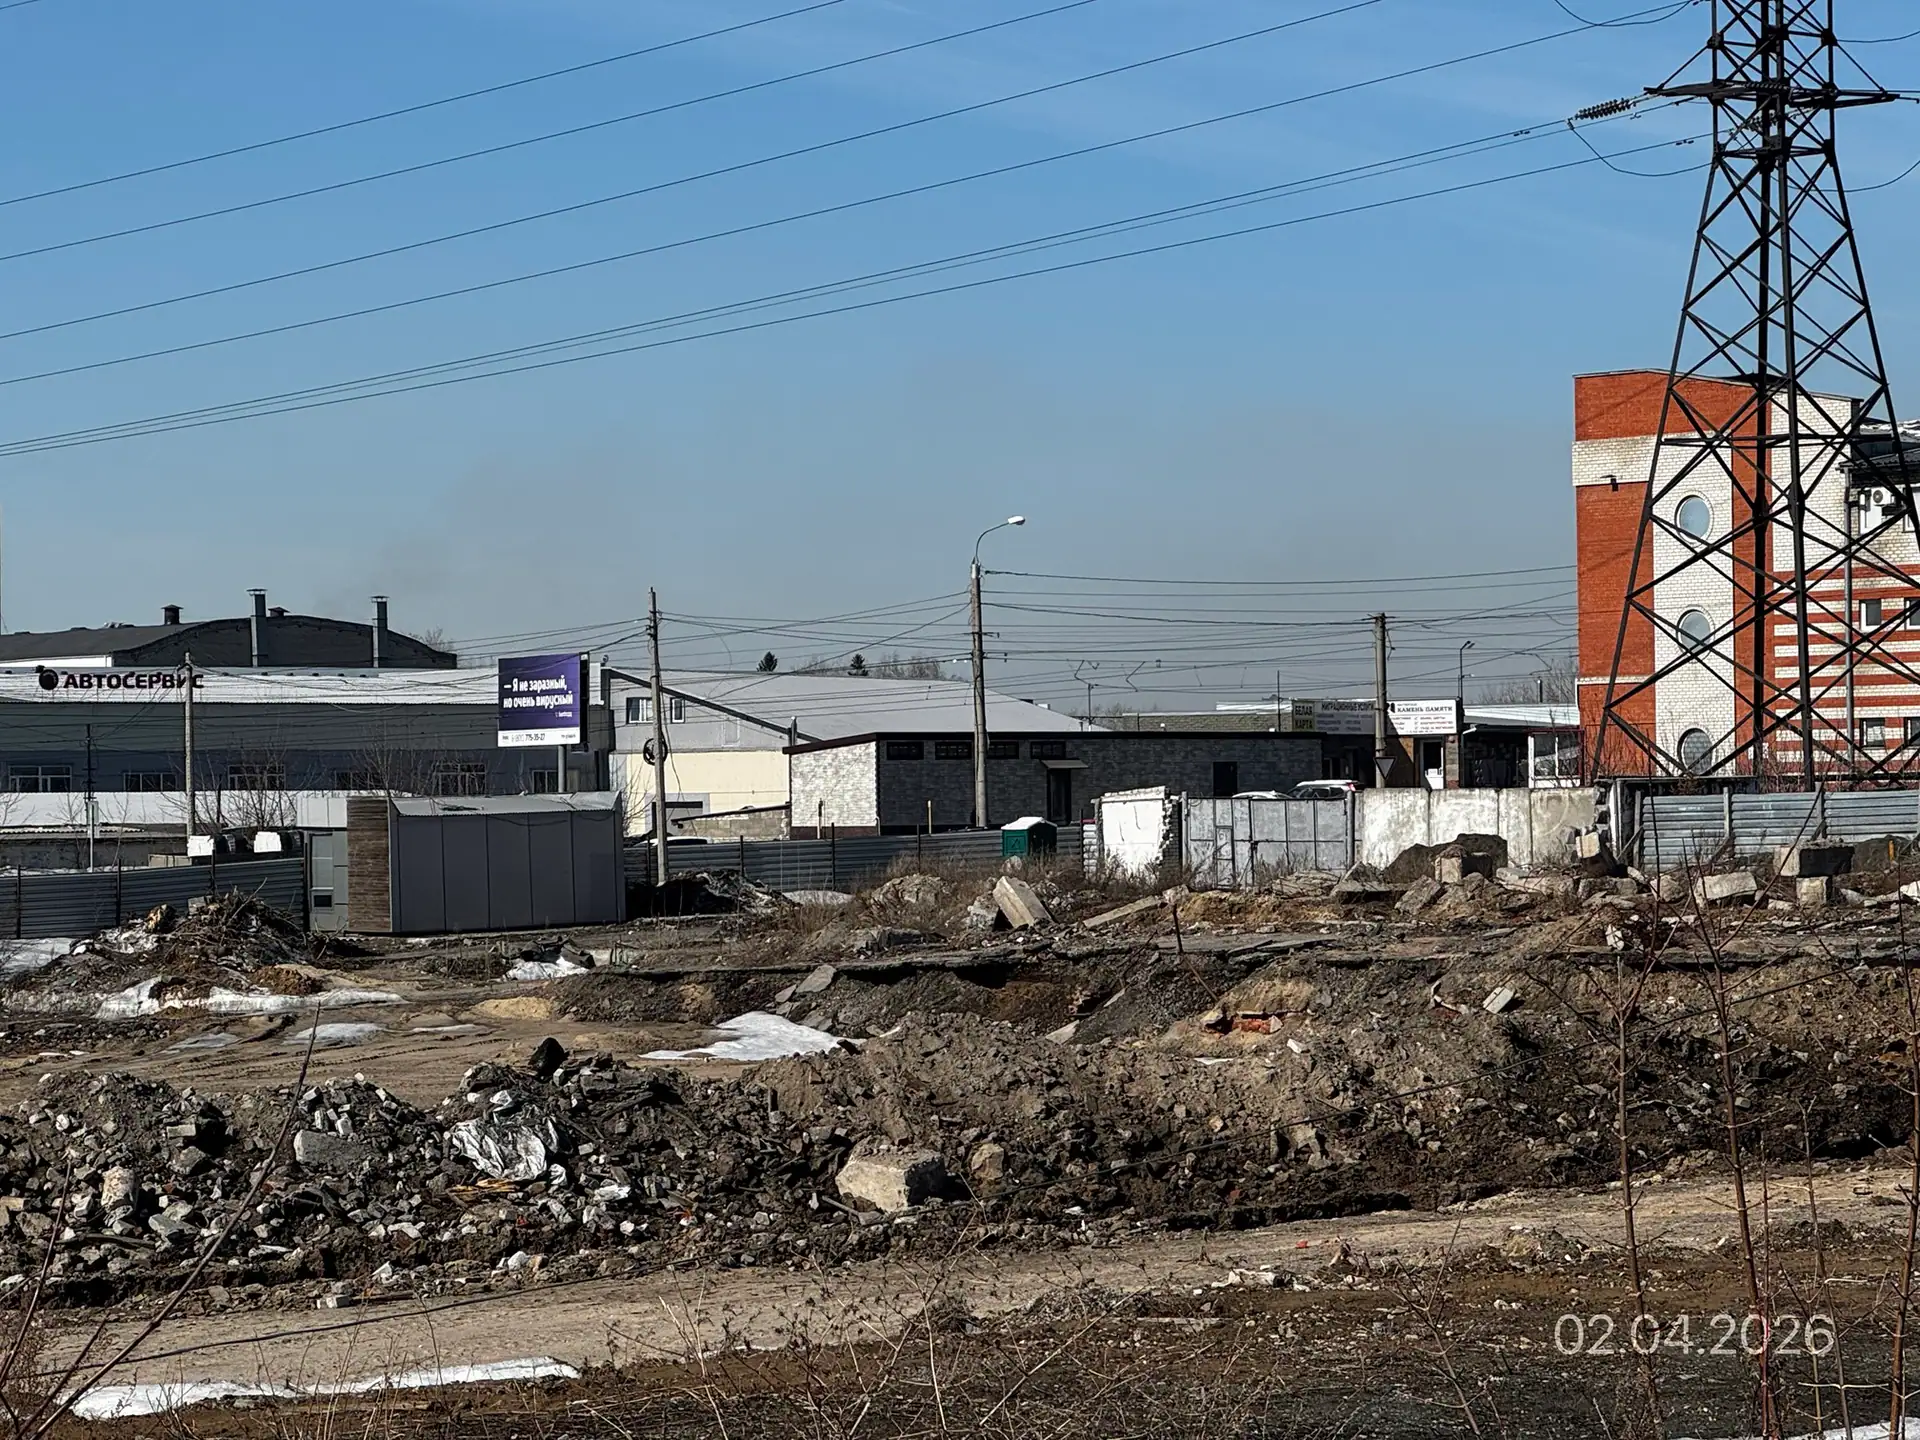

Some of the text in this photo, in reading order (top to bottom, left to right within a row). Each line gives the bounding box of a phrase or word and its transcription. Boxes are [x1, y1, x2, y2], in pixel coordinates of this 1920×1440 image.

[63, 674, 204, 689] АВТОСЕРВИС
[512, 678, 518, 692] Я
[519, 680, 528, 692] не
[529, 674, 567, 693] заразный,
[503, 690, 573, 709] но очень вирусный
